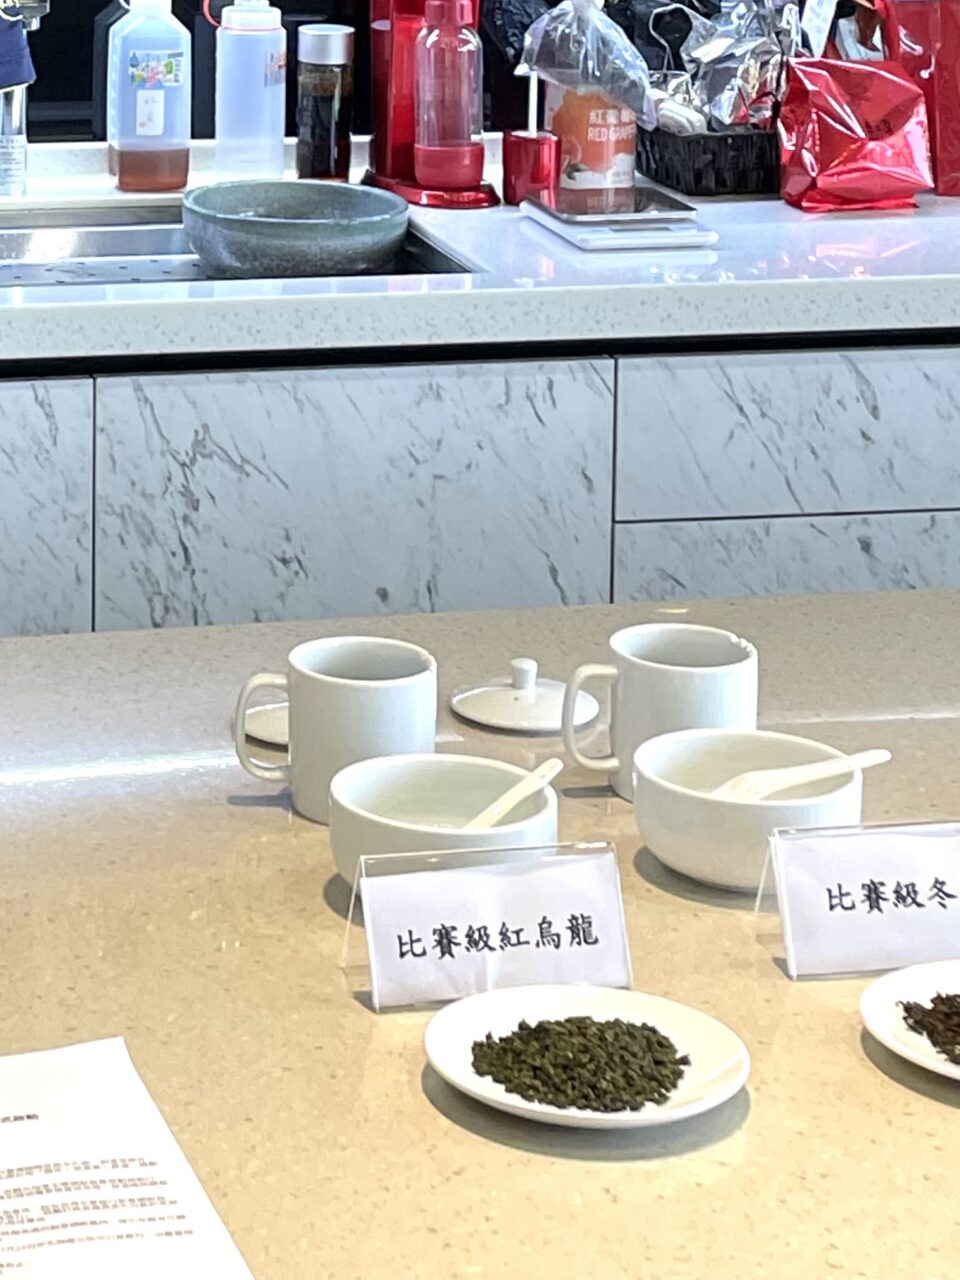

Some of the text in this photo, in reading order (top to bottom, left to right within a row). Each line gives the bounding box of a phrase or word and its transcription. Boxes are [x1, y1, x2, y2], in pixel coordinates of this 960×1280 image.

[397, 913, 600, 960] 比賽級紅烏龍
